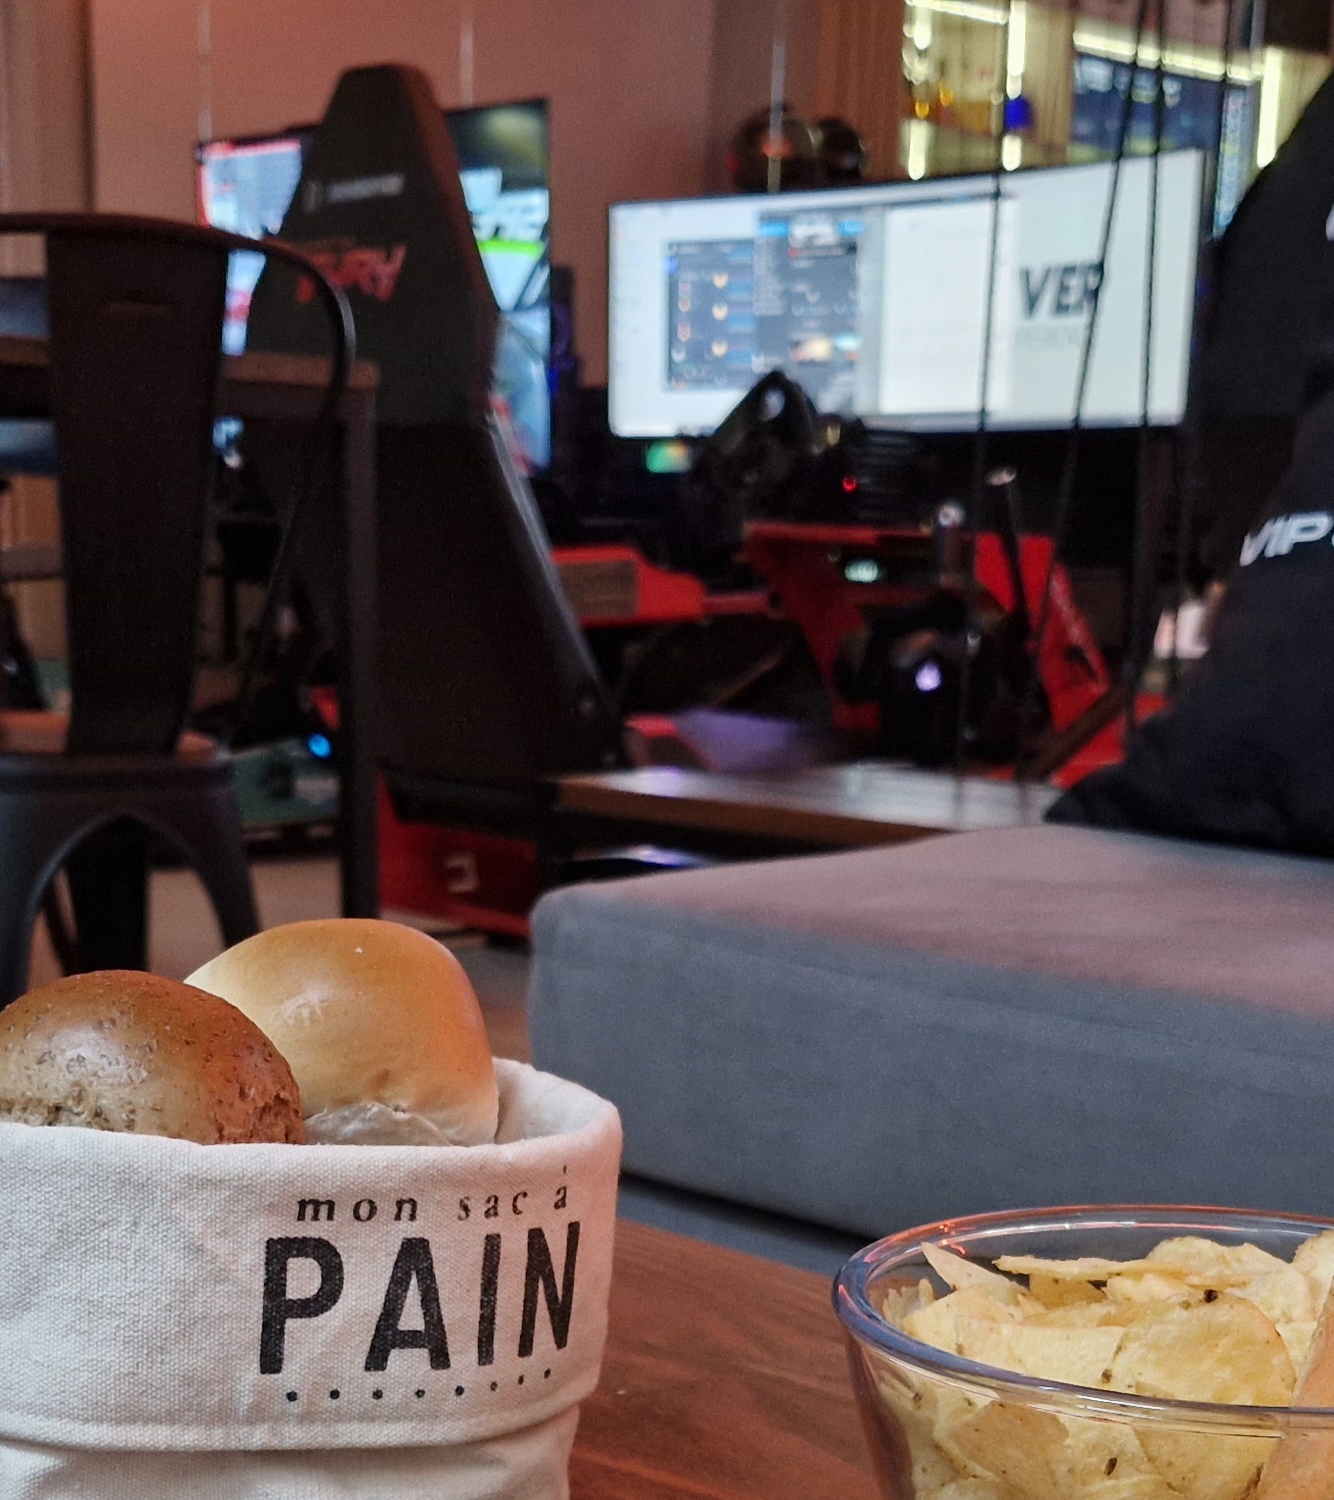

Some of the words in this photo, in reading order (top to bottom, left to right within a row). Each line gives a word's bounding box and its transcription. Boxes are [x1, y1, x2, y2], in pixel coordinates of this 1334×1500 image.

[296, 1197, 419, 1222] mon
[457, 1190, 528, 1221] sac
[259, 1221, 580, 1374] PAIN
